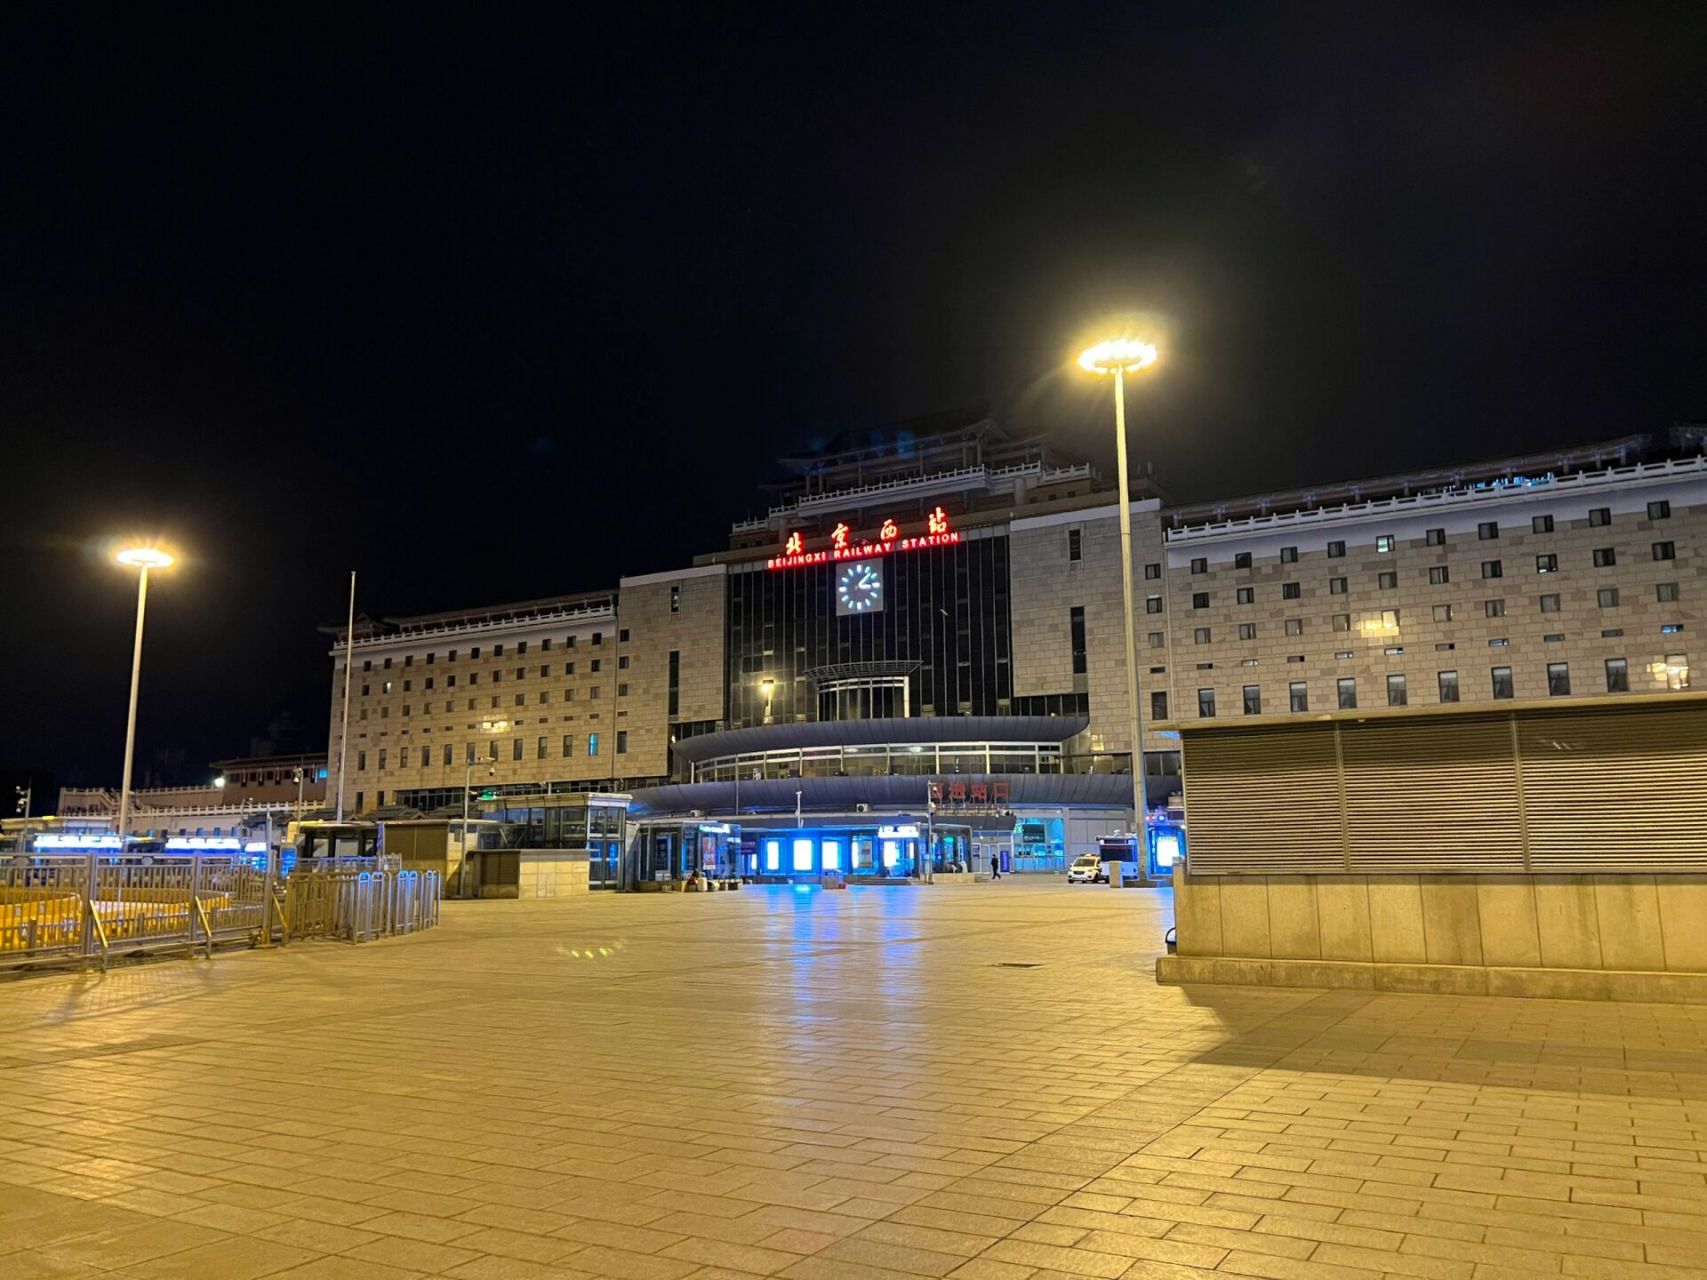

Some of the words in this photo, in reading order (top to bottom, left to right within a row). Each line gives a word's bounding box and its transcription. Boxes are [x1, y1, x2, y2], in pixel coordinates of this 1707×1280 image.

[767, 552, 826, 568] BEIJINGXI
[833, 542, 892, 560] RAILWAY
[902, 532, 960, 550] STATION
[785, 507, 947, 555] 北京西站
